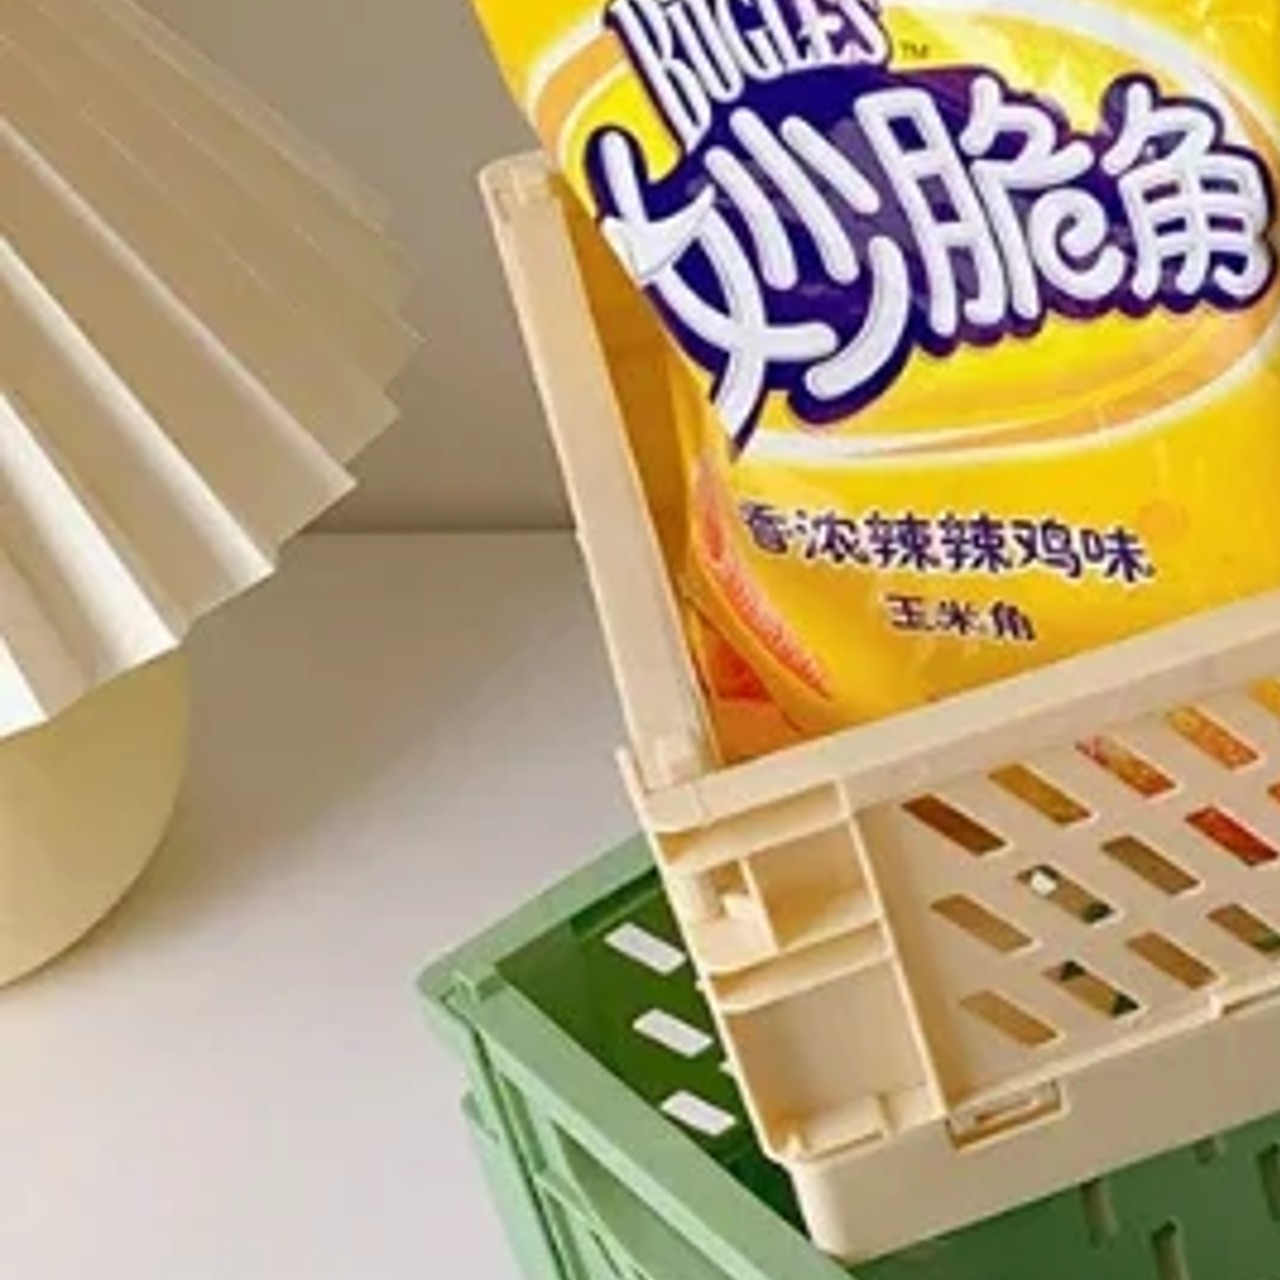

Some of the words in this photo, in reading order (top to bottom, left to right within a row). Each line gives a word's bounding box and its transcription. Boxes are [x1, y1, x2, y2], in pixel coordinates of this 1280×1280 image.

[588, 72, 1276, 450] 妙脆角
[741, 502, 1156, 583] 香浓辣辣鸡味
[885, 592, 1036, 640] 玉米角
